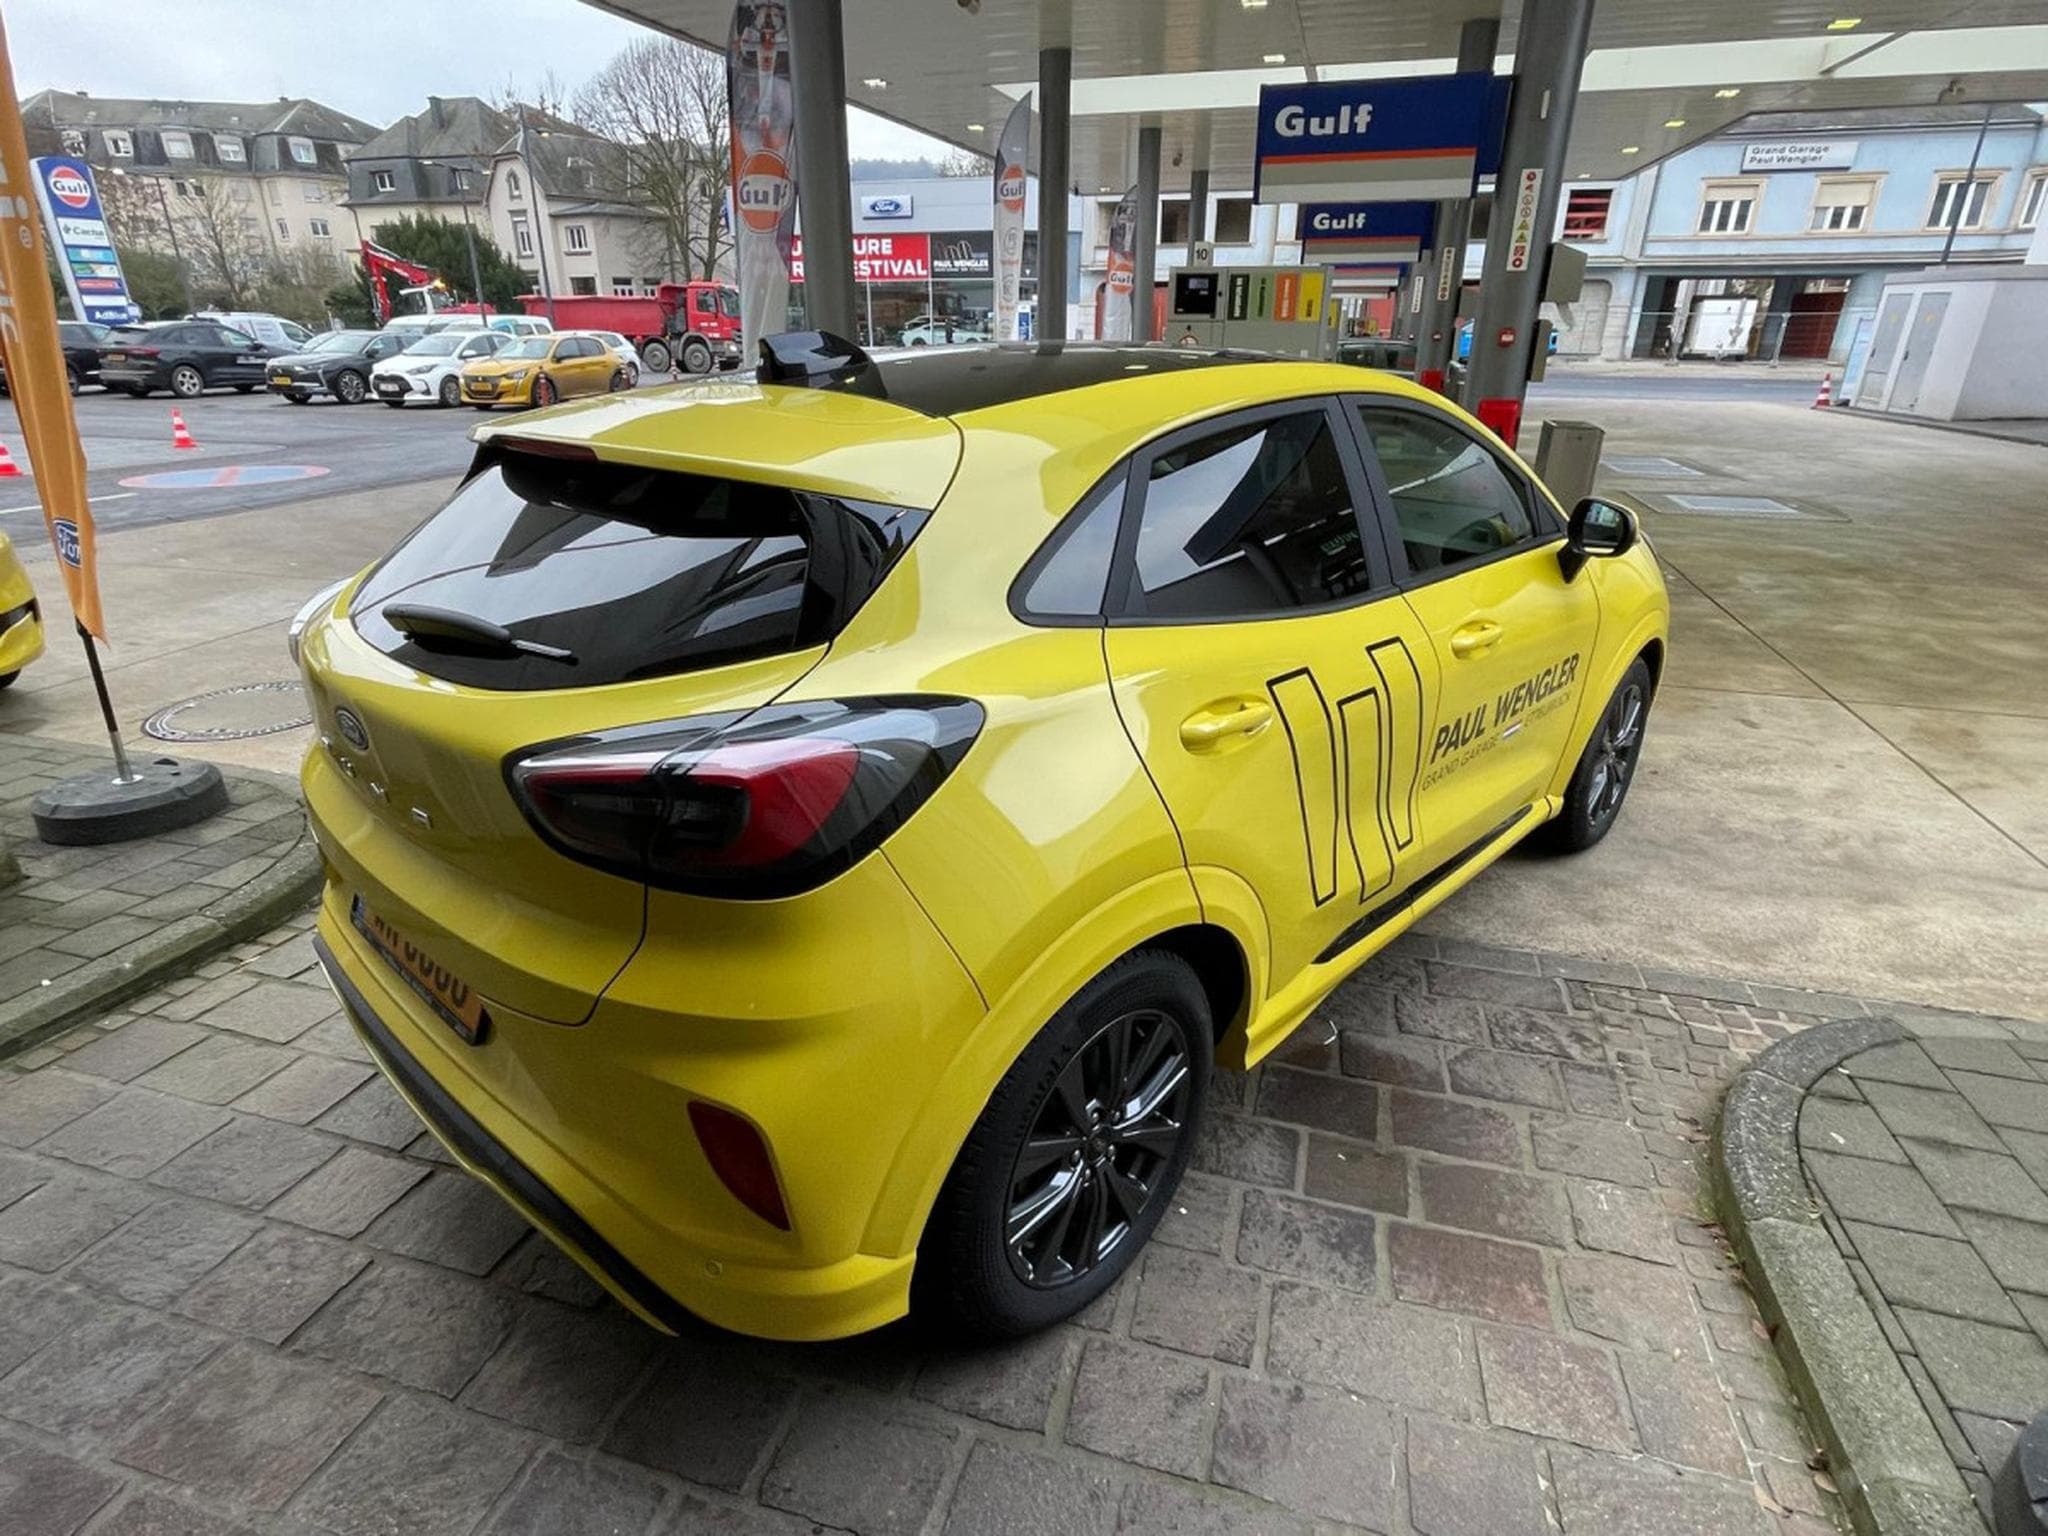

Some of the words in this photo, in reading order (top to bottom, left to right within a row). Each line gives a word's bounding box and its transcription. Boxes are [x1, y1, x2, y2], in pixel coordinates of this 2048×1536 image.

[1274, 103, 1374, 137] Gulf
[1752, 146, 1786, 155] Grand
[1788, 145, 1830, 154] Garage
[1749, 156, 1774, 164] Paul
[1776, 155, 1823, 164] Wengler
[53, 179, 89, 194] Gulf
[875, 200, 896, 211] Ford
[1312, 212, 1367, 230] Gulf
[1195, 248, 1209, 261] 10
[1430, 702, 1487, 765] PAUL
[1494, 652, 1580, 727] WENGLER
